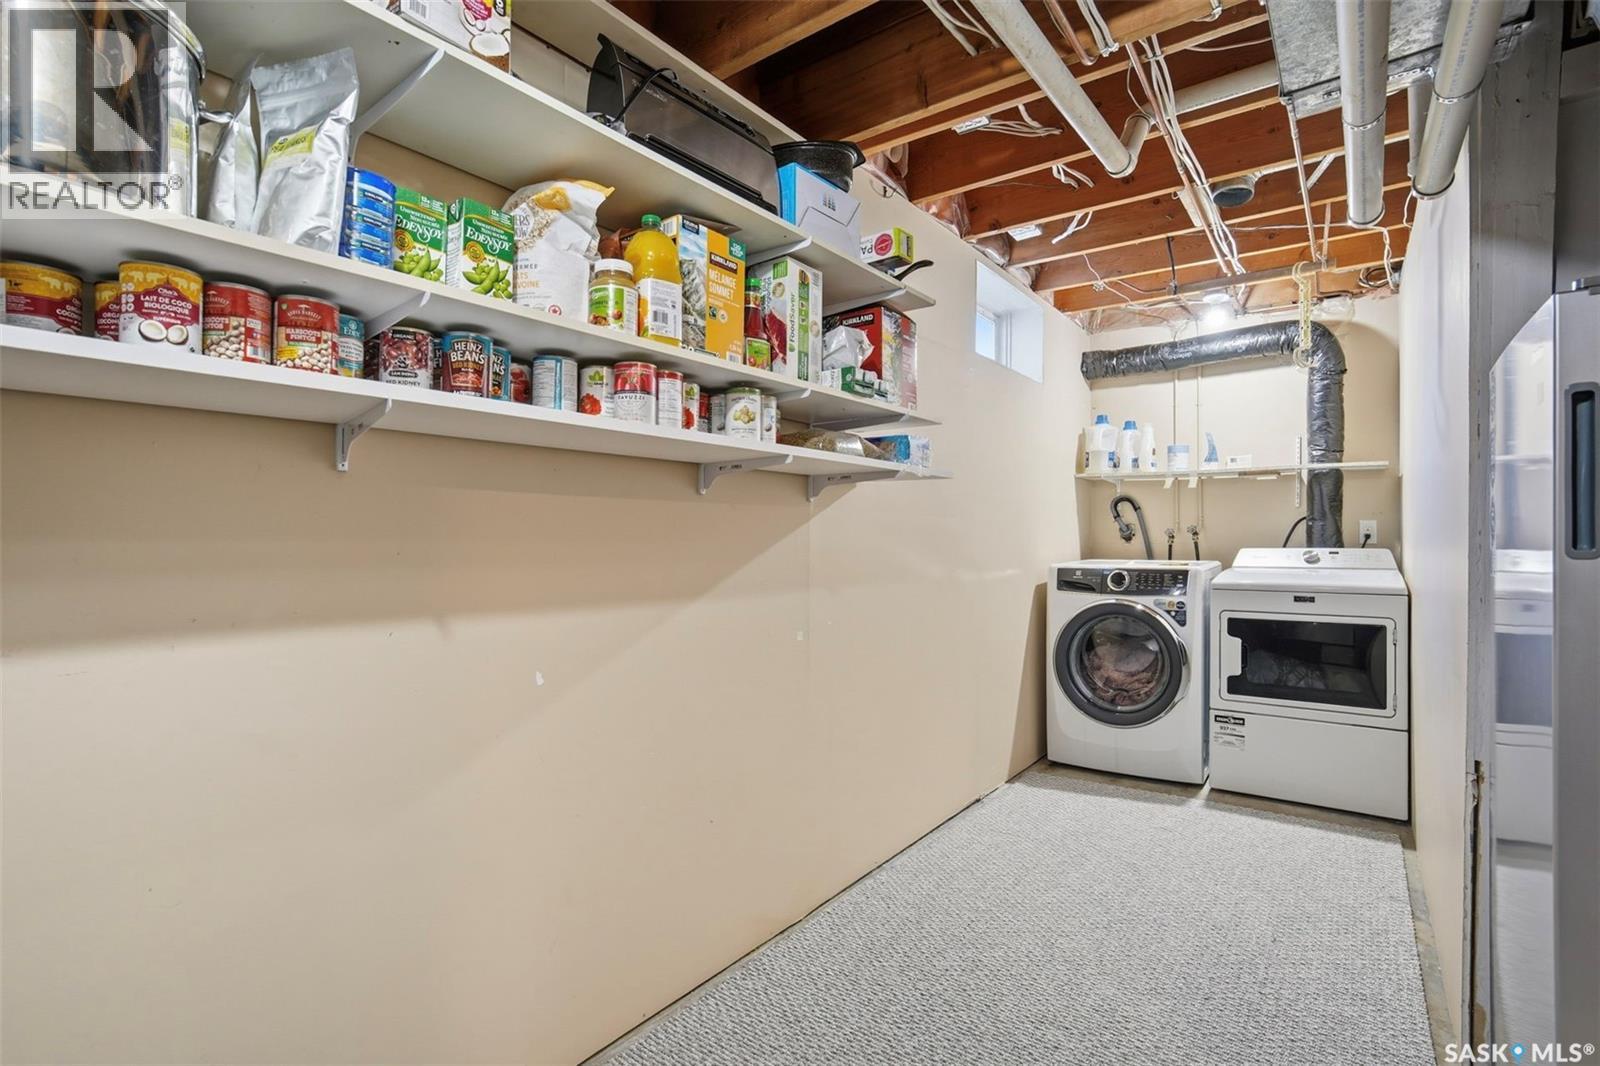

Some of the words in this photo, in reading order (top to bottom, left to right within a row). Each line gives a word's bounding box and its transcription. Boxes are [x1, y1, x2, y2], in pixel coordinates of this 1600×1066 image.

[465, 225, 512, 254] EDENSOY
[711, 253, 737, 270] KIRKLAND
[708, 268, 736, 289] MÉLANGE
[708, 281, 733, 300] SOMMET
[143, 301, 190, 315] BIOLOGIQUE
[171, 299, 193, 310] COCO
[789, 292, 797, 343] FoodSaver
[842, 314, 874, 326] KIRKLAND
[454, 341, 482, 354] HEINZ
[450, 350, 485, 365] BEANS
